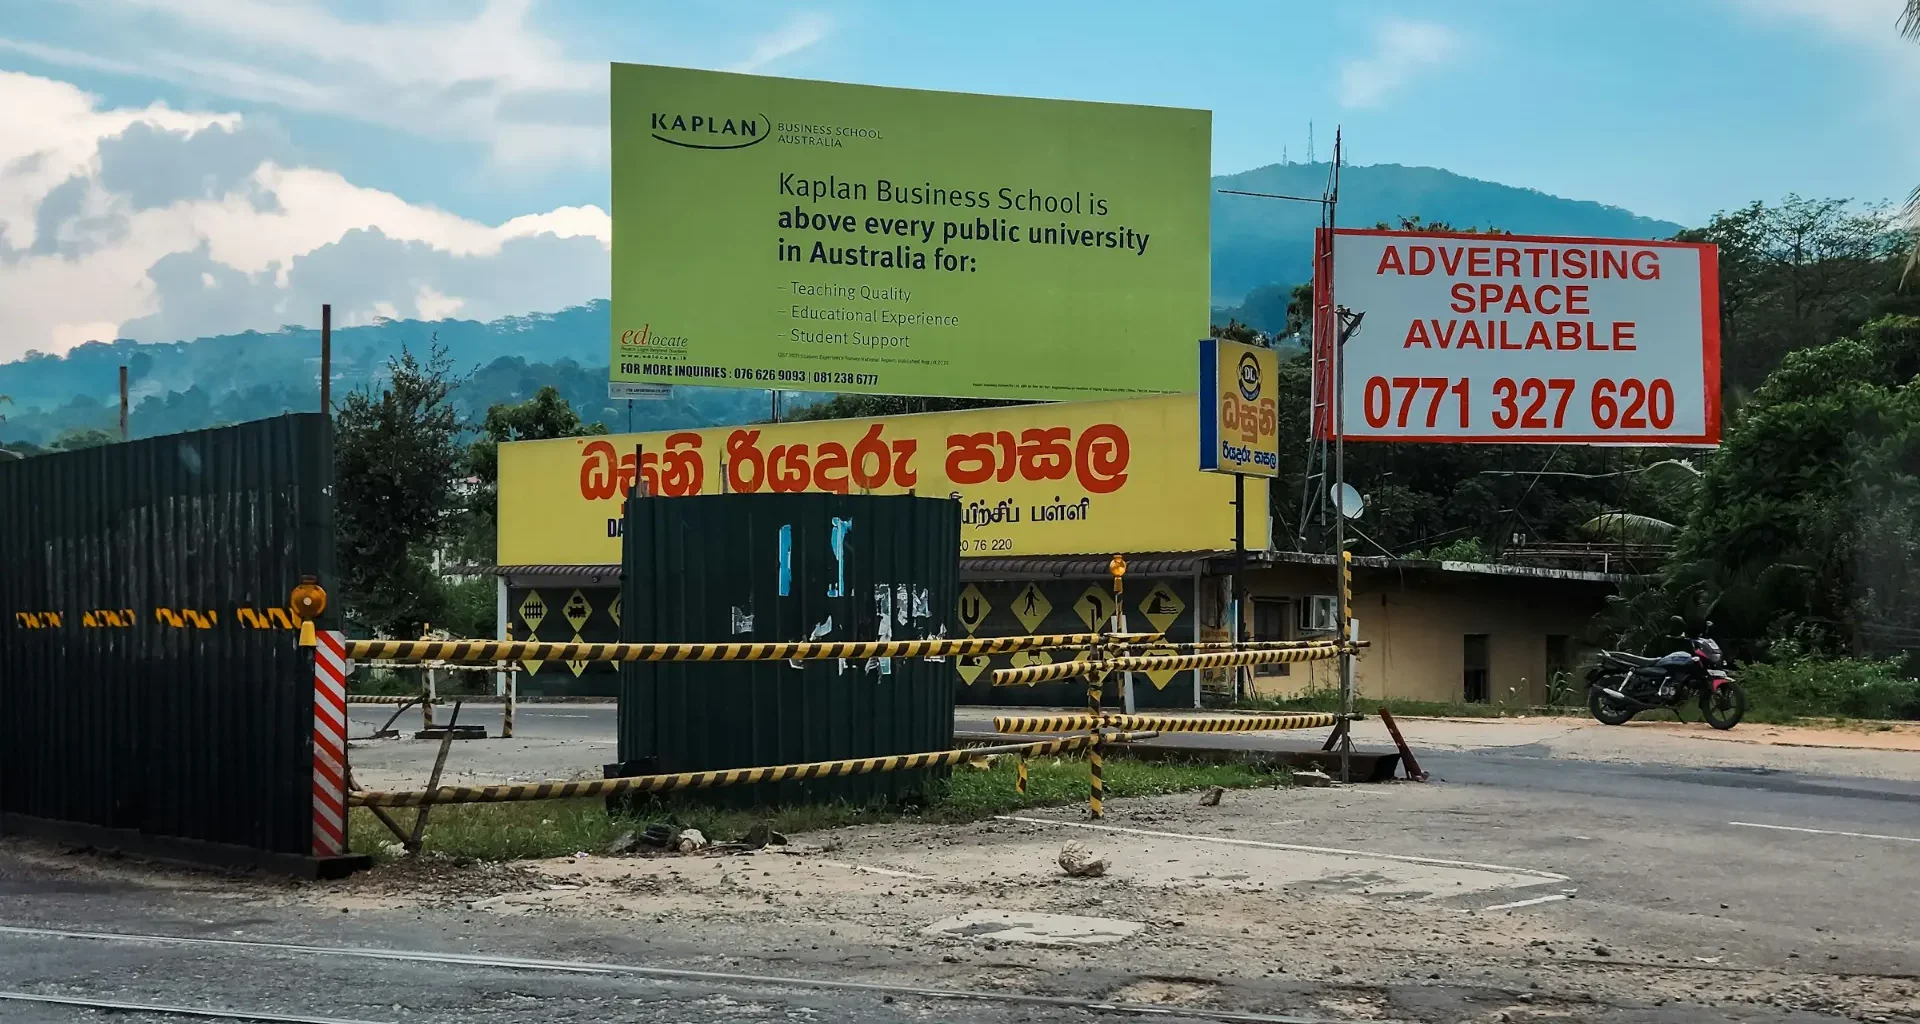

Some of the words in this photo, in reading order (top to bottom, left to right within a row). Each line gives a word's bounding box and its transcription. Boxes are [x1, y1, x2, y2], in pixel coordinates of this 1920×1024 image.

[652, 112, 756, 137] KAPLAN
[778, 122, 832, 135] BUSINESS
[836, 127, 883, 139] SCHOOL
[778, 135, 843, 148] AUSTRALIA
[779, 172, 867, 204] Kaplan
[878, 179, 990, 208] Business
[998, 187, 1082, 214] School
[1089, 193, 1108, 216] is
[778, 206, 856, 232] above
[865, 216, 935, 243] every
[943, 218, 1020, 244] public
[1029, 223, 1150, 256] university
[778, 238, 801, 262] in
[810, 241, 926, 270] Australia
[934, 247, 977, 272] for:
[1376, 245, 1660, 280] ADVERTISING
[791, 282, 856, 300] Teaching
[860, 285, 912, 303] Quality
[1450, 284, 1590, 315] SPACE
[791, 305, 877, 322] Educational
[882, 310, 959, 327] Experience
[621, 324, 688, 347] edlocate
[791, 328, 848, 345] Student
[852, 331, 910, 349] Support
[1403, 319, 1637, 352] AVAILABLE
[621, 363, 640, 374] FOR
[643, 364, 672, 376] MORE
[675, 365, 727, 378] INQUIRIES
[734, 368, 753, 379] 076
[755, 369, 775, 380] 626
[778, 370, 806, 382] 9093
[814, 372, 831, 383] 081
[834, 373, 854, 384] 238
[856, 374, 878, 386] 6777
[1363, 375, 1470, 429] 0771
[1491, 377, 1576, 430] 327
[1591, 378, 1675, 430] 620
[1222, 391, 1276, 444] ධසුනි
[579, 431, 704, 502] ධසනි
[945, 424, 1130, 494] පාසල
[1222, 440, 1251, 466] රියදුරු
[1254, 451, 1276, 469] පාසල
[1032, 496, 1090, 522] பள்ளி
[974, 540, 987, 551] 76
[991, 539, 1013, 550] 220
